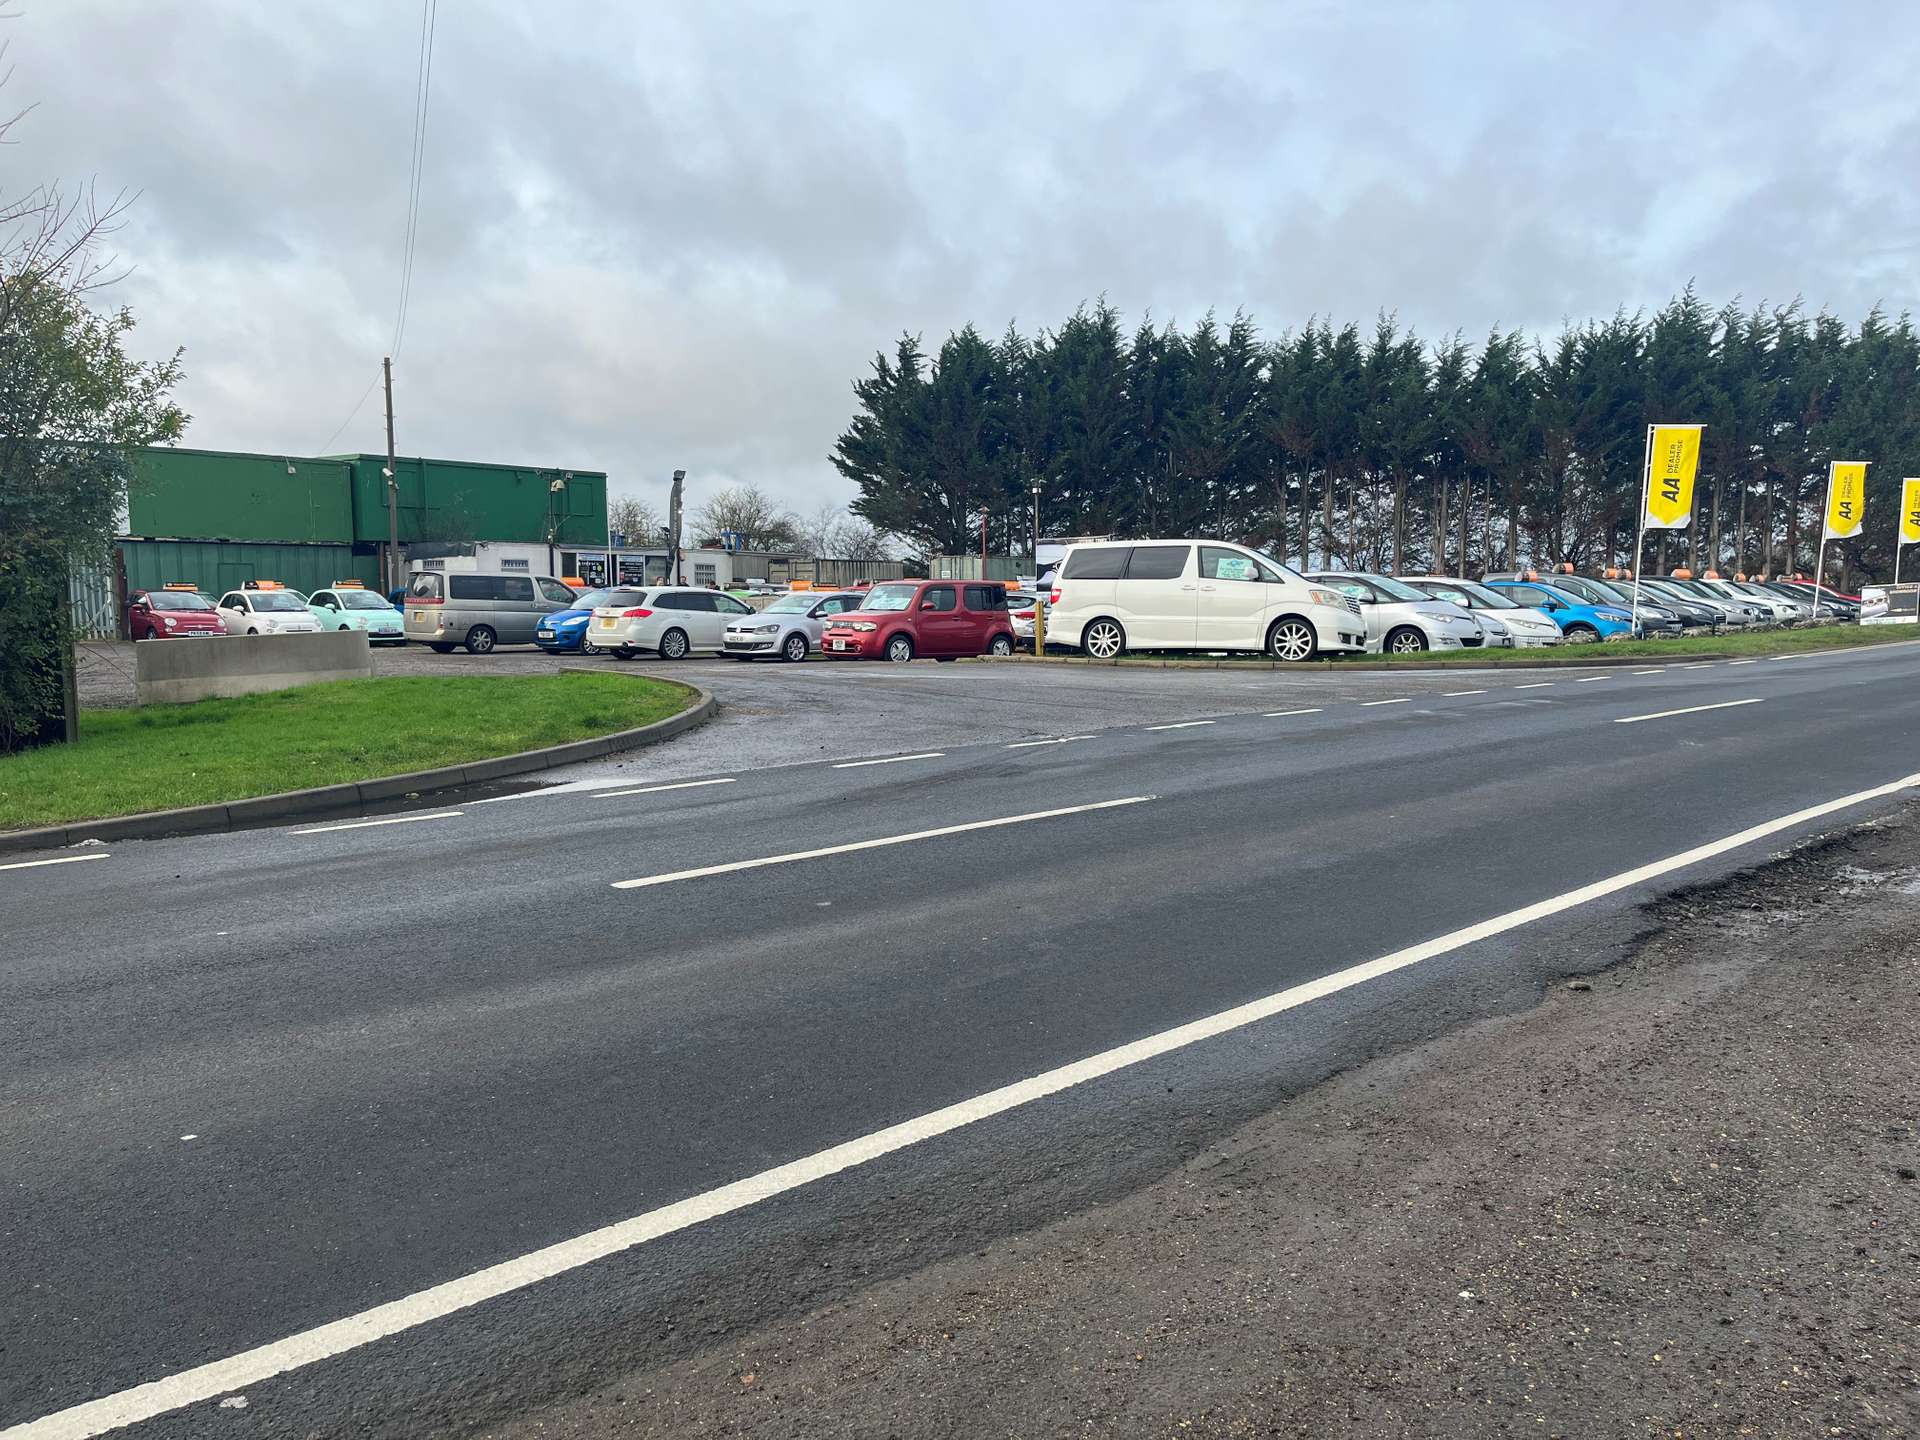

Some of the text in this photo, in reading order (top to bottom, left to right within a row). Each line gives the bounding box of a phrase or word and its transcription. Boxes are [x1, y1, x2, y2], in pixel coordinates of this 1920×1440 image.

[1667, 444, 1676, 474] DEALER
[1674, 439, 1684, 474] PROMISE
[1661, 478, 1681, 503] AA
[1838, 501, 1852, 520] AA
